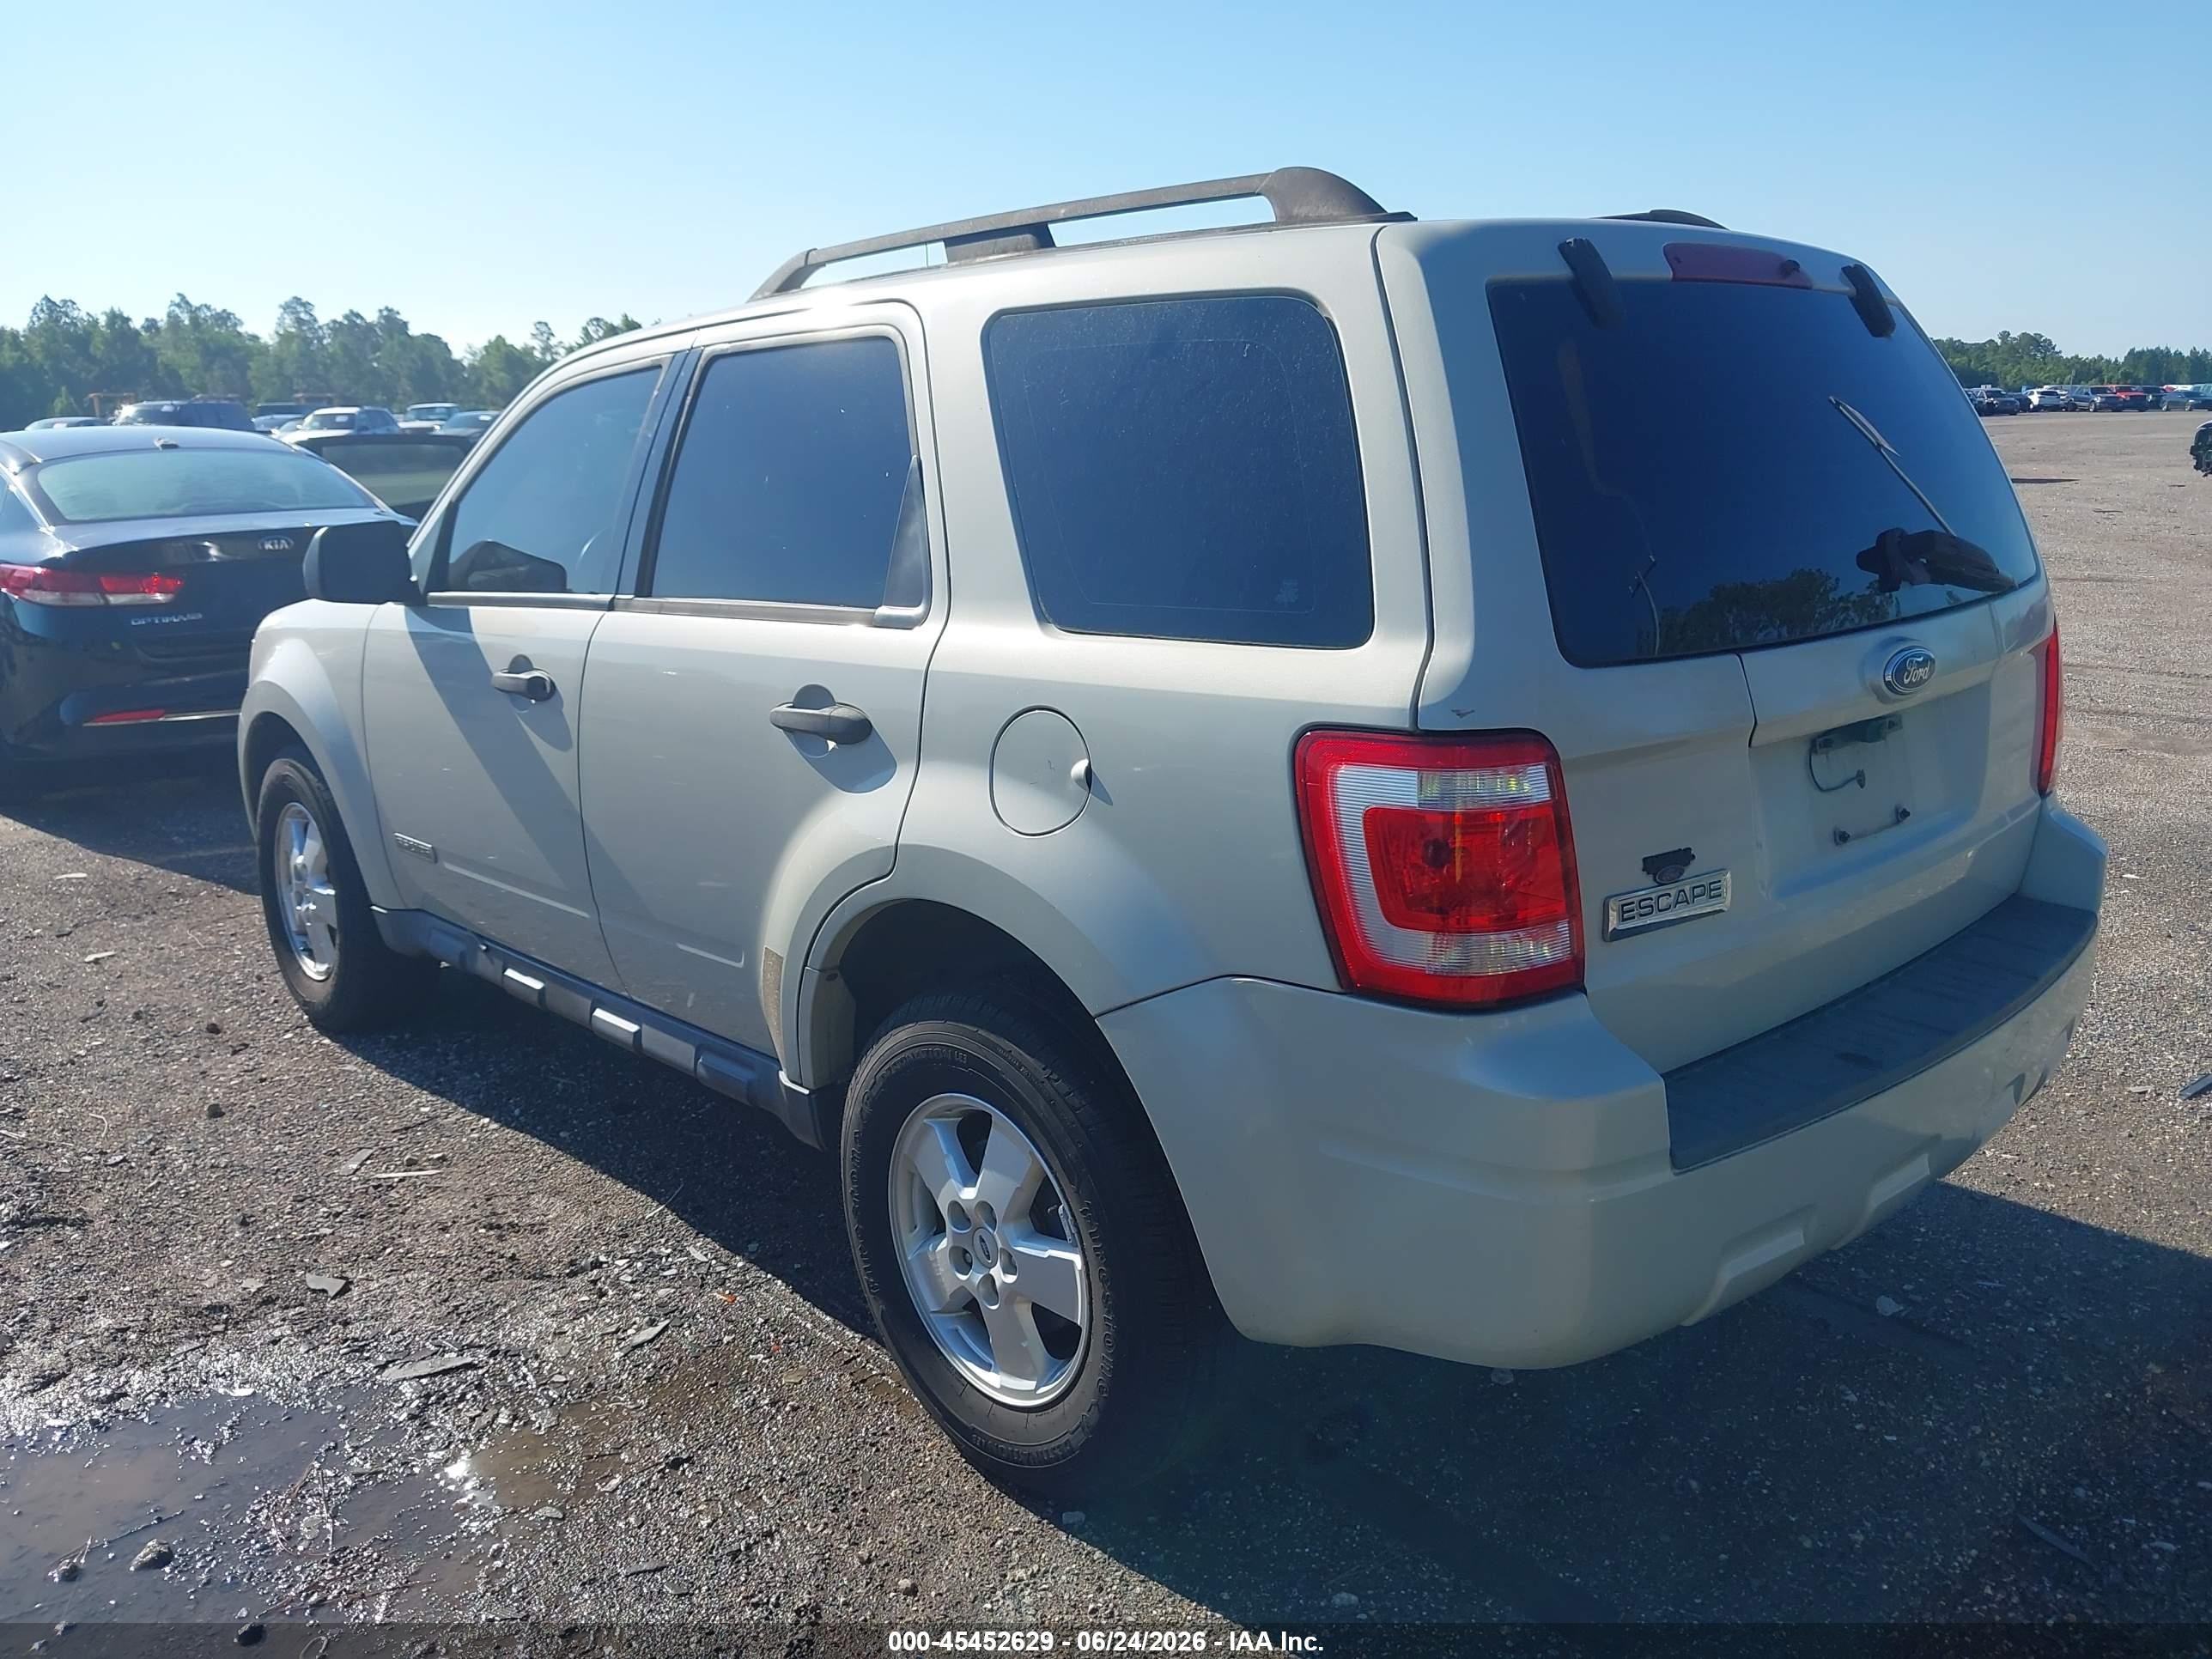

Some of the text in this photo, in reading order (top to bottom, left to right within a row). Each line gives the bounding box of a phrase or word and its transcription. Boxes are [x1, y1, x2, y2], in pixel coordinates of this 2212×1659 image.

[264, 539, 289, 550] KIA
[1903, 655, 1930, 684] Ford
[1620, 879, 1723, 923] ESCAPE
